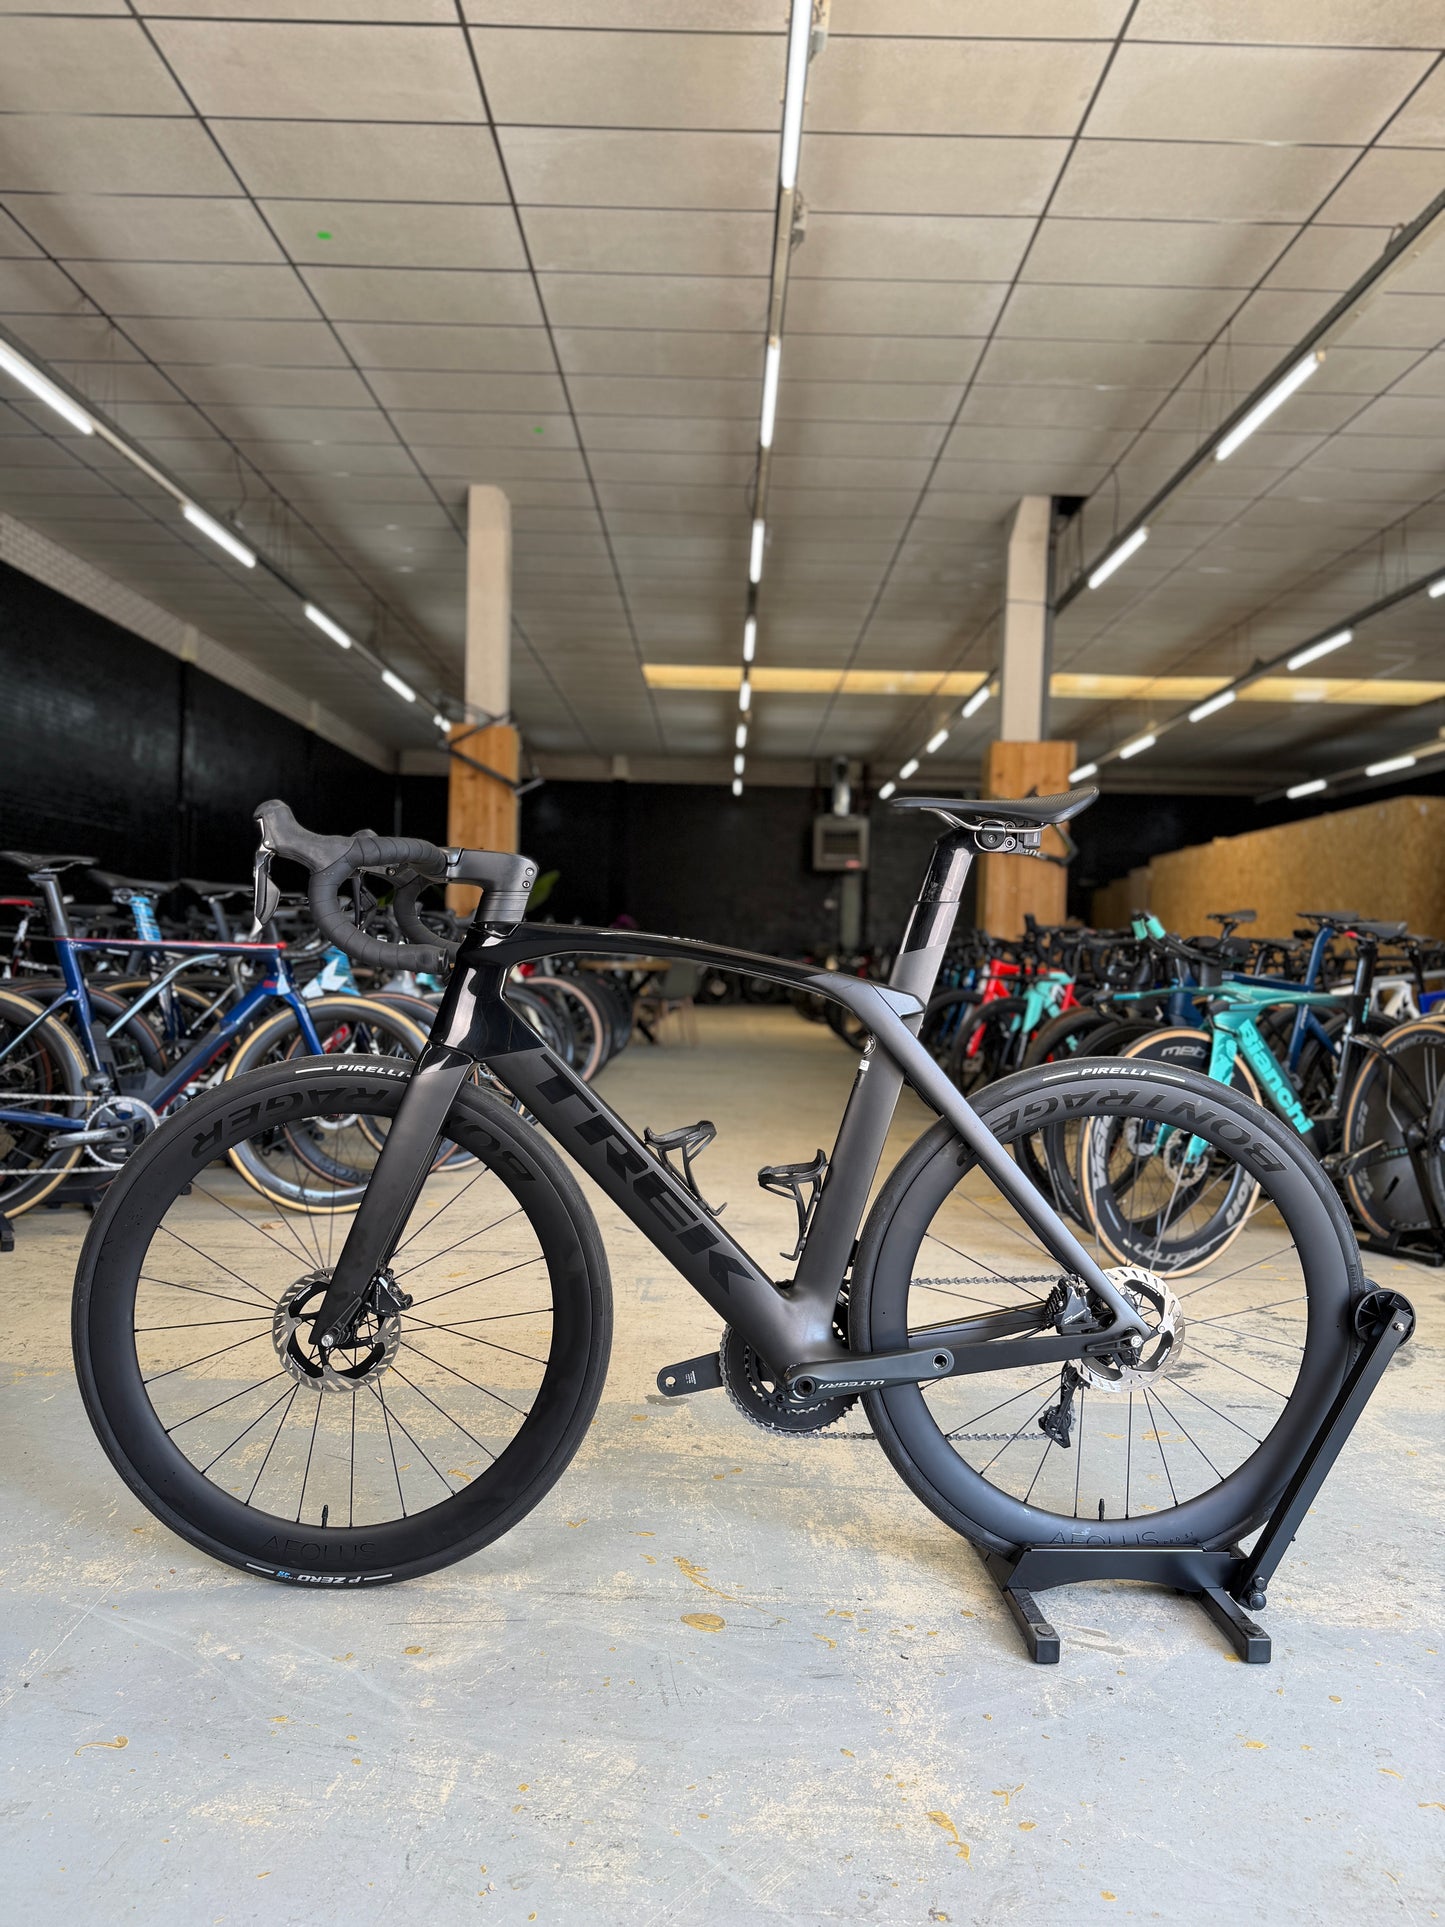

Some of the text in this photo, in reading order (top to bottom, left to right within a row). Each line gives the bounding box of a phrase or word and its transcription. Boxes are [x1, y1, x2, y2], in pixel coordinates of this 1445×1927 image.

[336, 1064, 405, 1077] PIRELLI
[1081, 1067, 1148, 1077] PIRELLI
[1239, 1018, 1315, 1134] Bianchi
[957, 1088, 1288, 1173] BONTRAGE
[536, 1053, 757, 1295] TREK
[818, 1379, 885, 1390] ULTEGRA
[297, 1574, 347, 1584] ZERO
[348, 1576, 362, 1584] P
